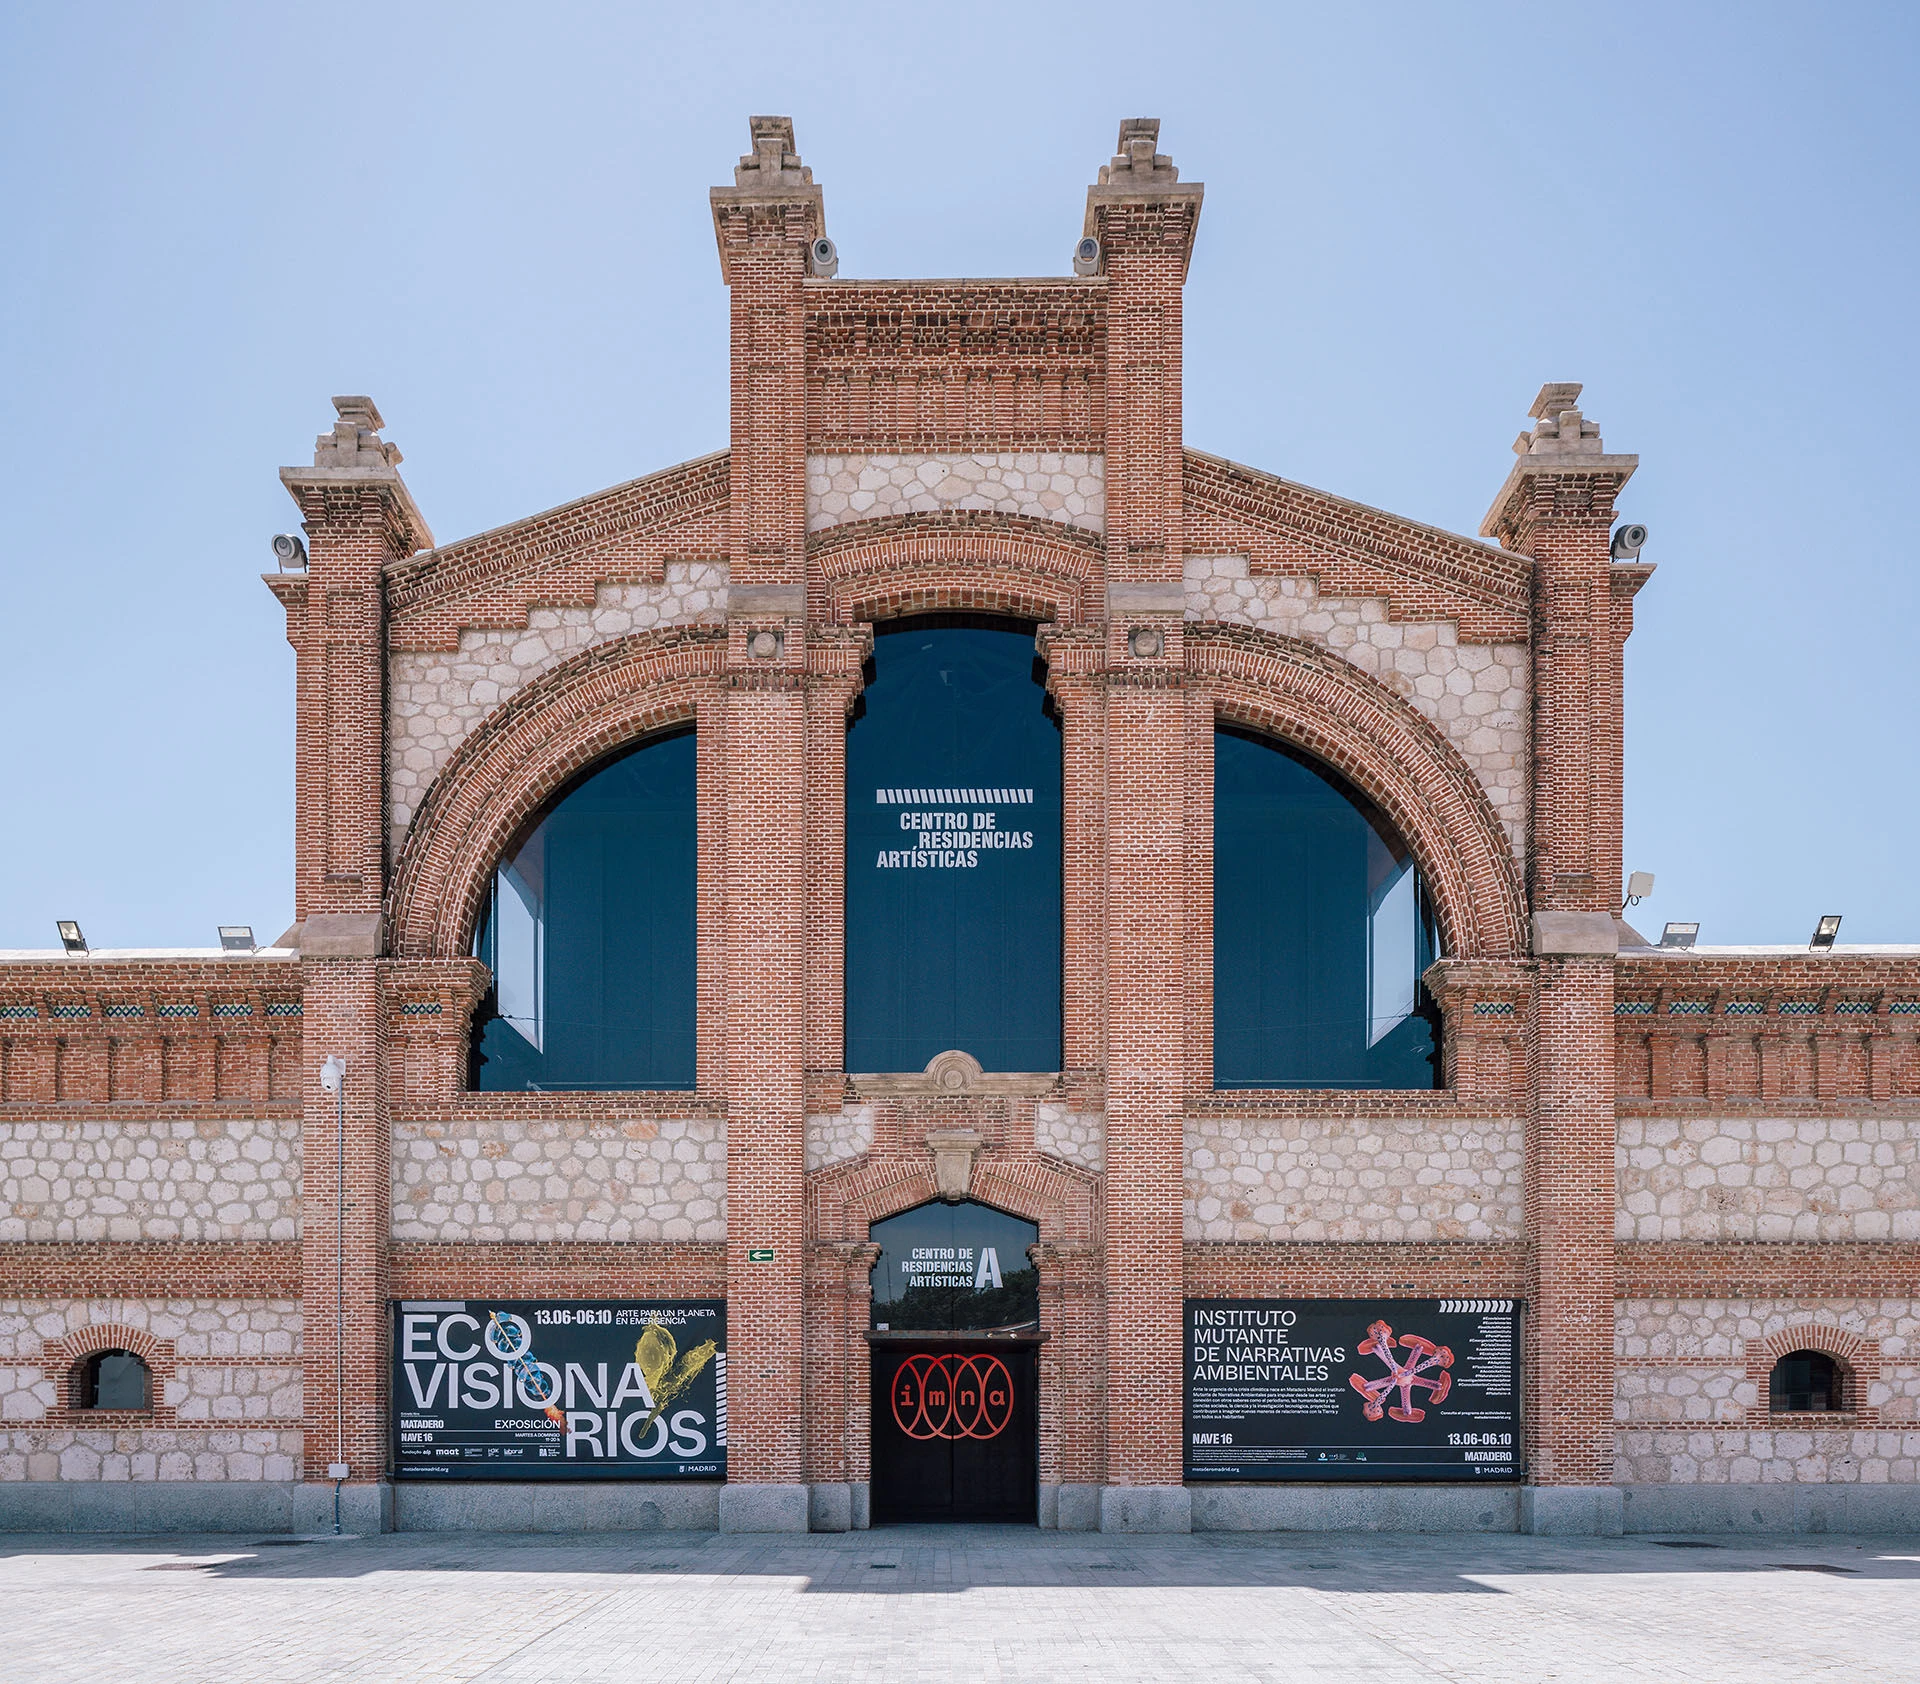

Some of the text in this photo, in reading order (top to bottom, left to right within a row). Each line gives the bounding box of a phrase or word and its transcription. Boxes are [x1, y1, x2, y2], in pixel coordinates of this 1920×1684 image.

[900, 812, 996, 830] CENTRO DE
[918, 832, 1034, 849] RESIDENCIAS
[876, 846, 978, 868] ARTÍSTICAS
[912, 1248, 973, 1259] CENTRO DE
[902, 1261, 973, 1273] RESIDENCIAS
[974, 1248, 1004, 1288] A
[909, 1273, 973, 1287] ARTÍSTICAS
[534, 1310, 612, 1324] 13.06-06.10
[1194, 1310, 1297, 1326] INSTITUTO
[403, 1314, 532, 1361] ECO
[1194, 1328, 1289, 1344] MUTANTE
[1194, 1347, 1346, 1363] DE NARRATIVAS
[1193, 1365, 1329, 1381] AMBIENTALES
[401, 1420, 444, 1429] MATADERO
[494, 1418, 560, 1429] EXPOSICIÓN
[401, 1433, 433, 1442] NAVE 16
[566, 1410, 707, 1458] RIOS
[1192, 1433, 1233, 1444] NAVE 16
[1448, 1433, 1512, 1445] 13.06-06.10
[1464, 1452, 1512, 1461] MATADERO
